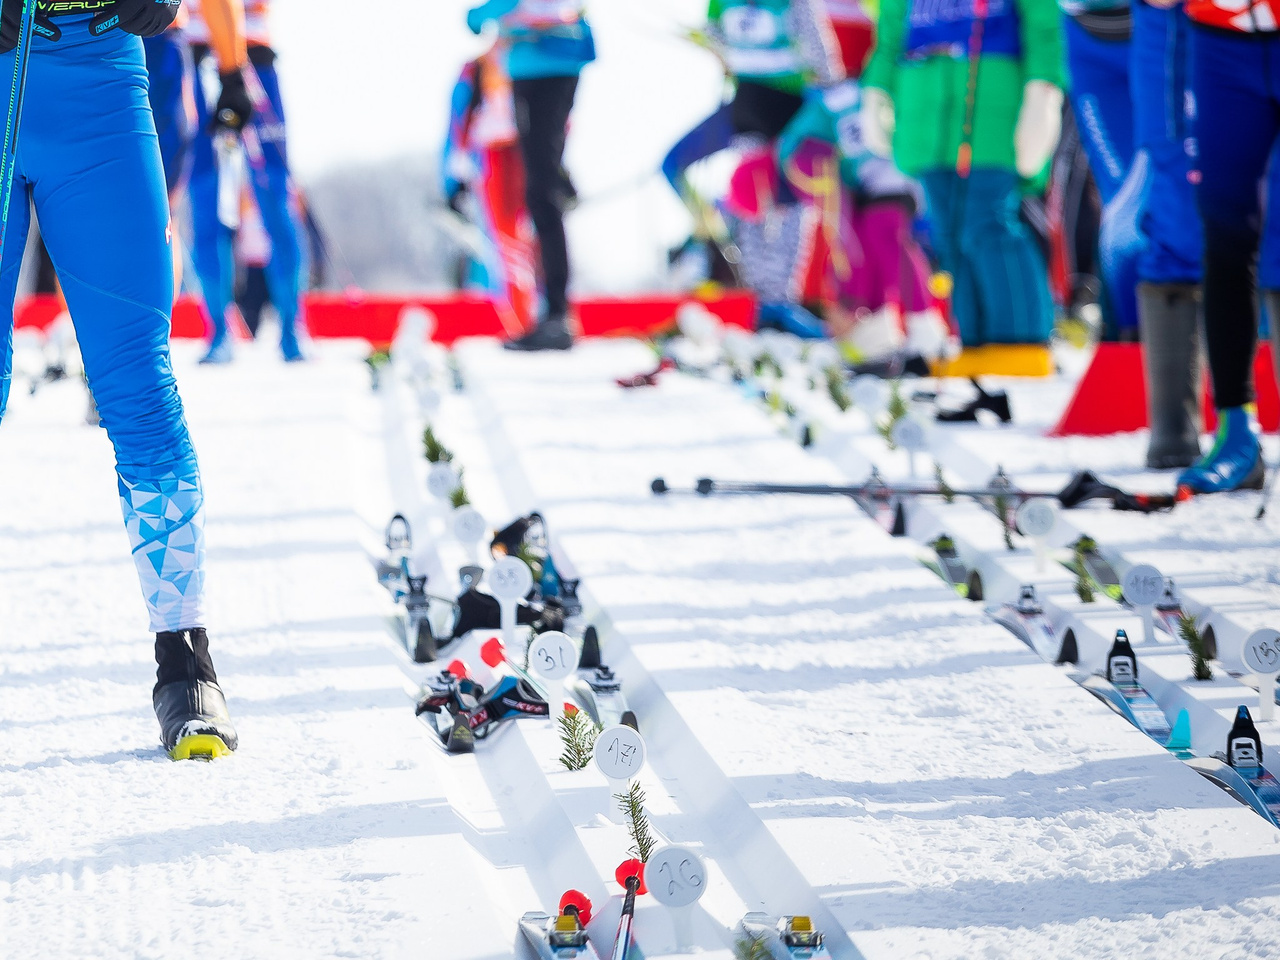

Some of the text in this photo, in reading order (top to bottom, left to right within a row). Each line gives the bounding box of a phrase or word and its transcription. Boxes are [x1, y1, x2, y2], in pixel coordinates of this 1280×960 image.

[95, 15, 120, 34] KV+
[537, 646, 566, 672] 31
[658, 857, 702, 897] 26
